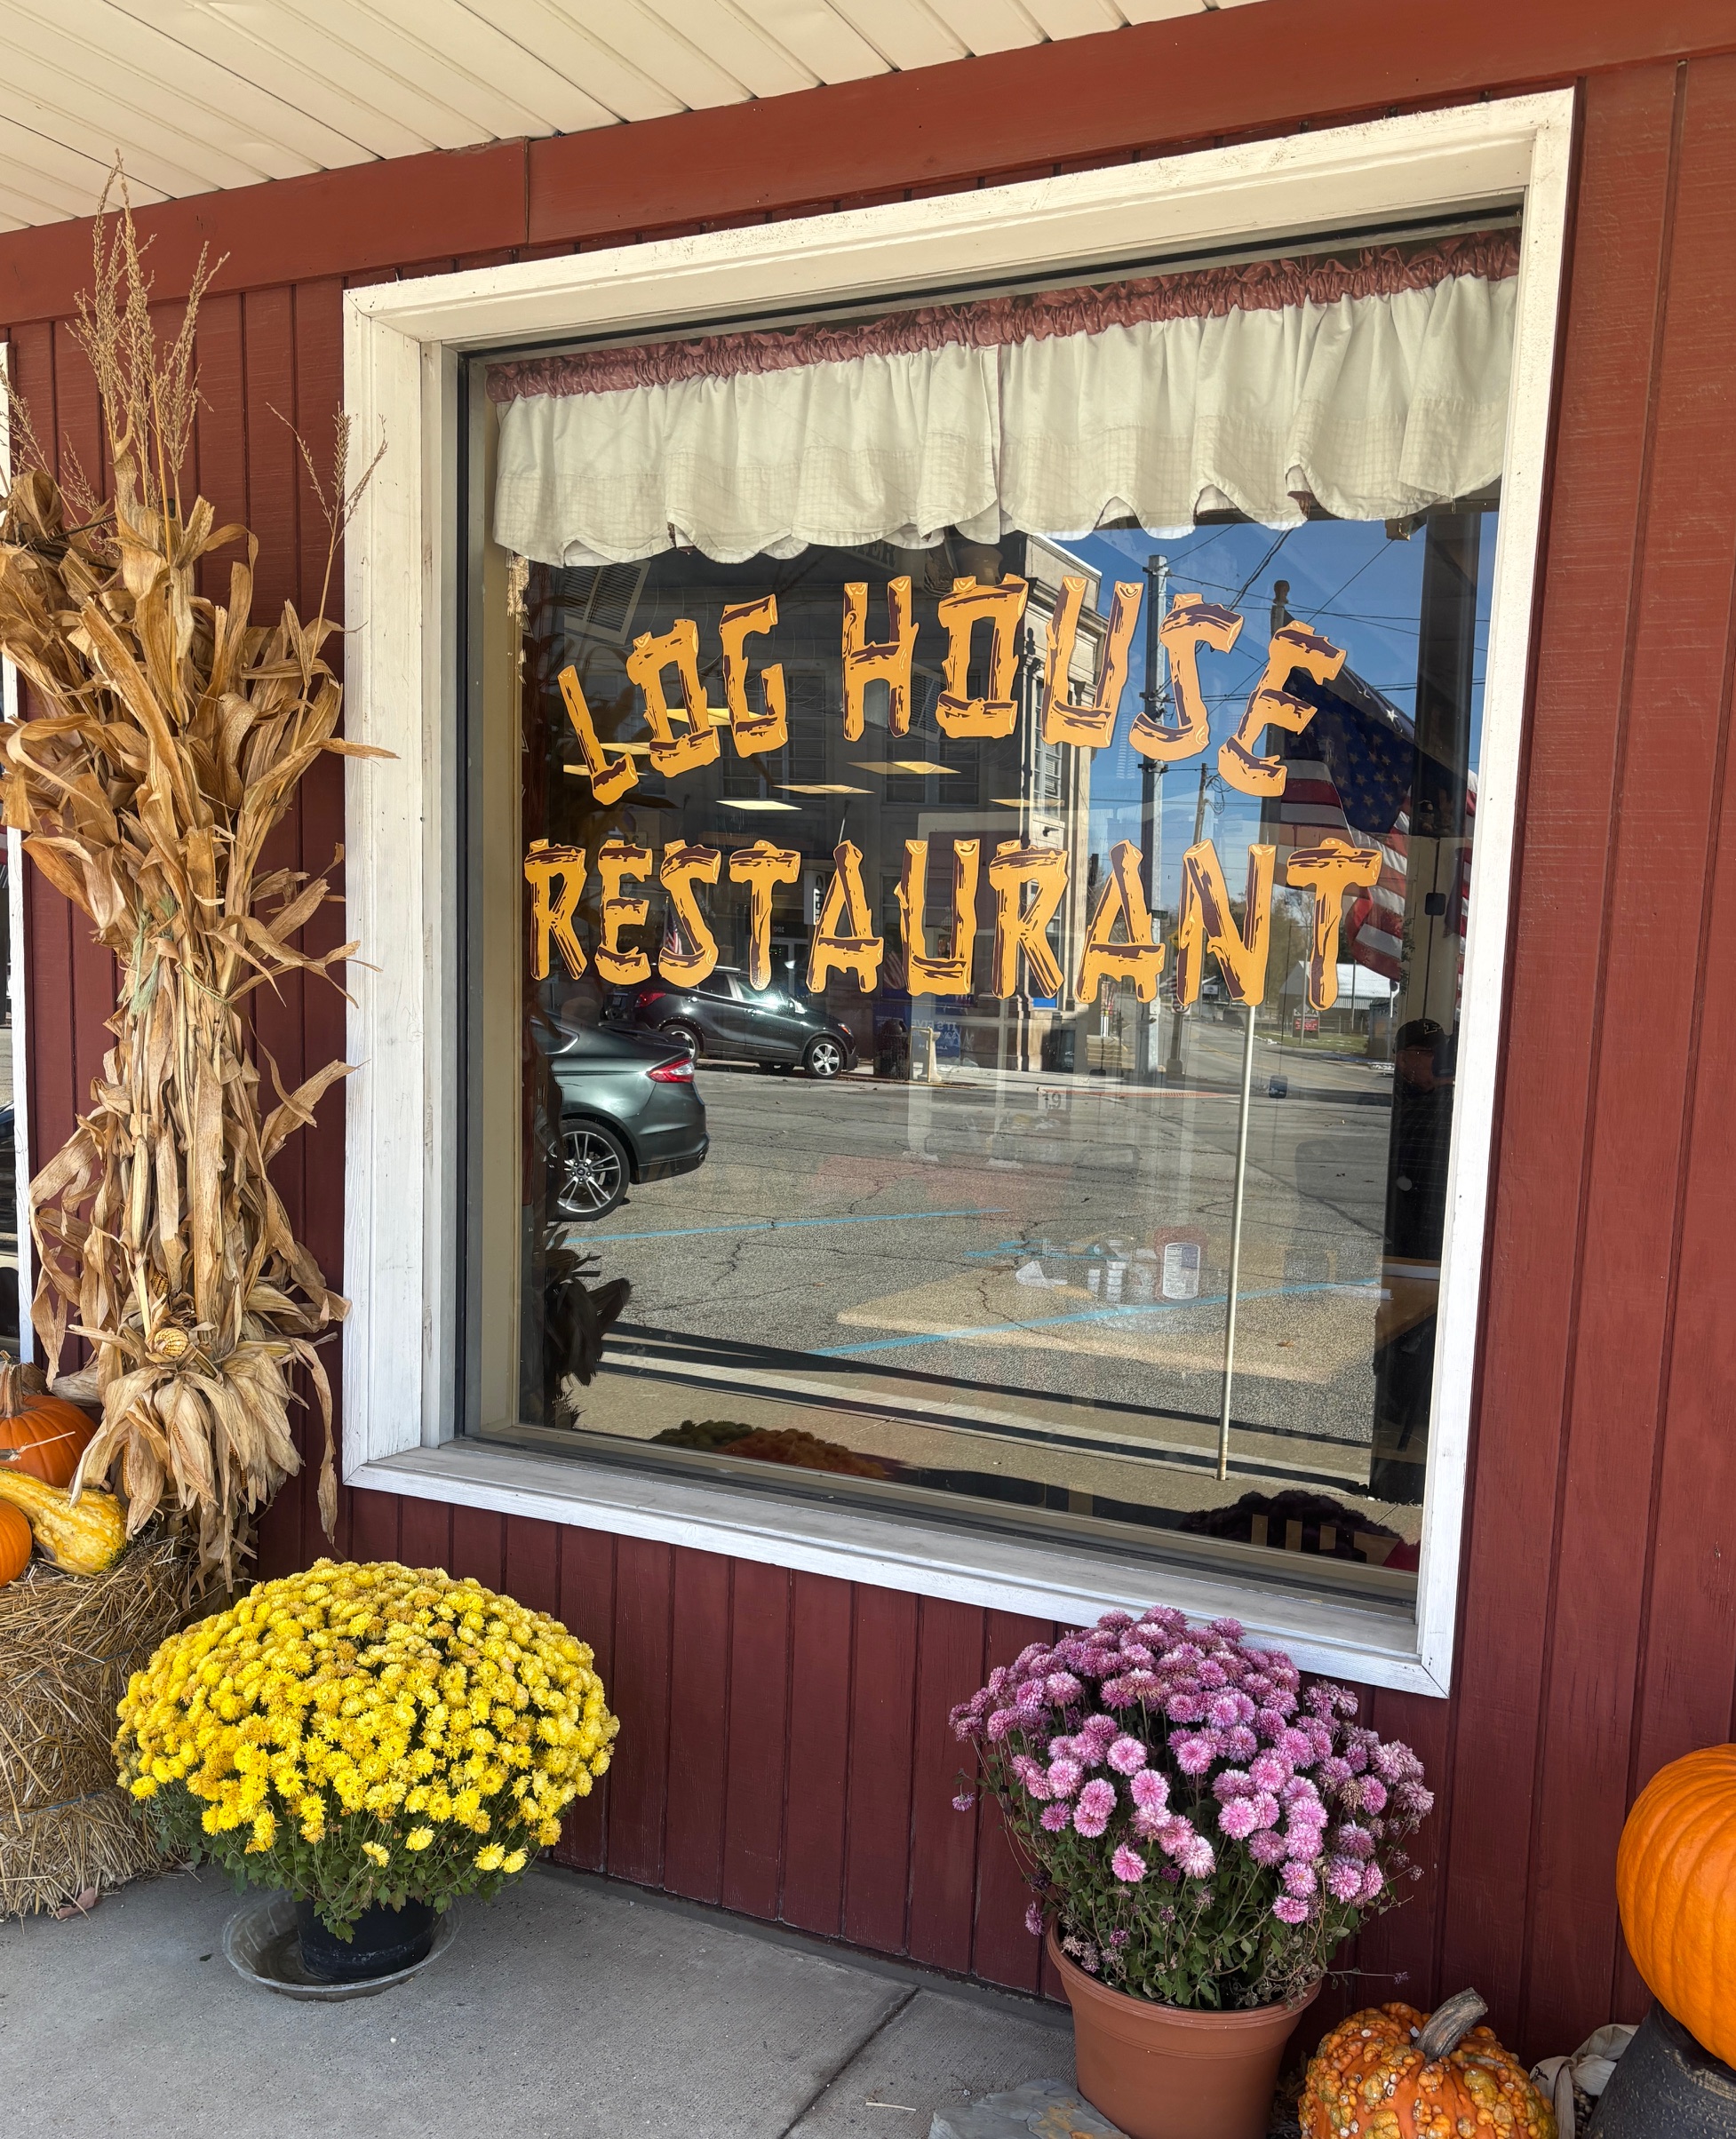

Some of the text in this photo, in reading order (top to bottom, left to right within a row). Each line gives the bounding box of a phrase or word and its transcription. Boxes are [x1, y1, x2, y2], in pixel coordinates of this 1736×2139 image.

[558, 575, 1347, 805] LOG HOUSE
[524, 838, 1382, 1010] RESTAURANT
[1042, 1093, 1062, 1109] 19
